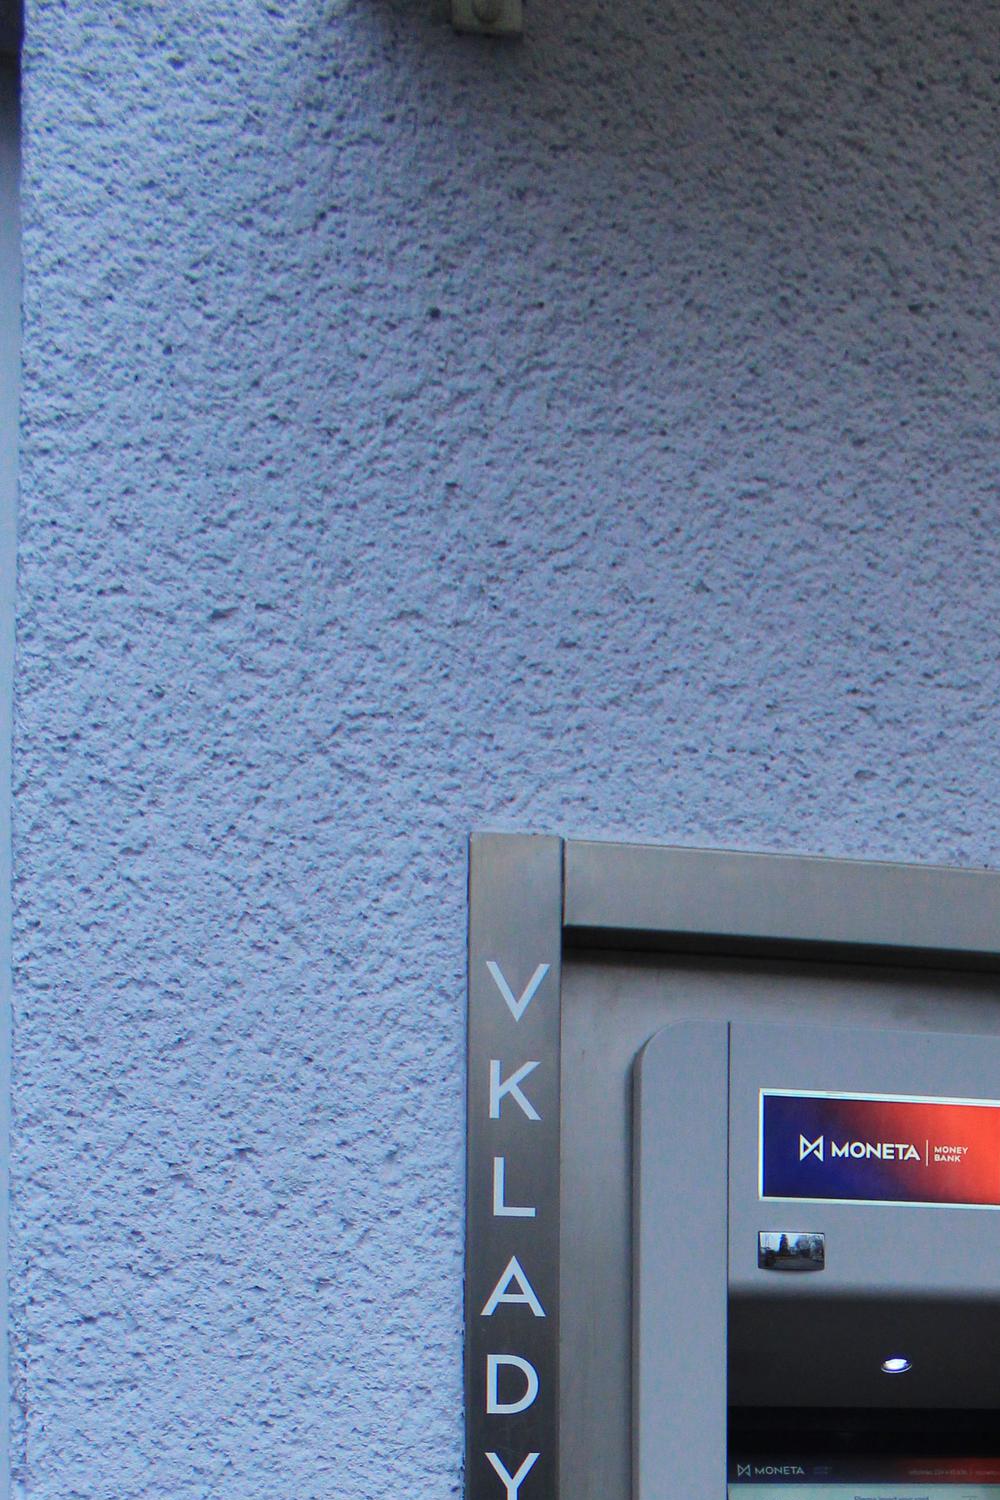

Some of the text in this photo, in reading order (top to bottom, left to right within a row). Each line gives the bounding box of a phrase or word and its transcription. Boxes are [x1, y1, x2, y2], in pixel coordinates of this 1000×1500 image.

[831, 1140, 921, 1160] MONETA
[934, 1145, 969, 1155] MONEY
[934, 1153, 962, 1162] BANK
[754, 1466, 805, 1475] MONETA
